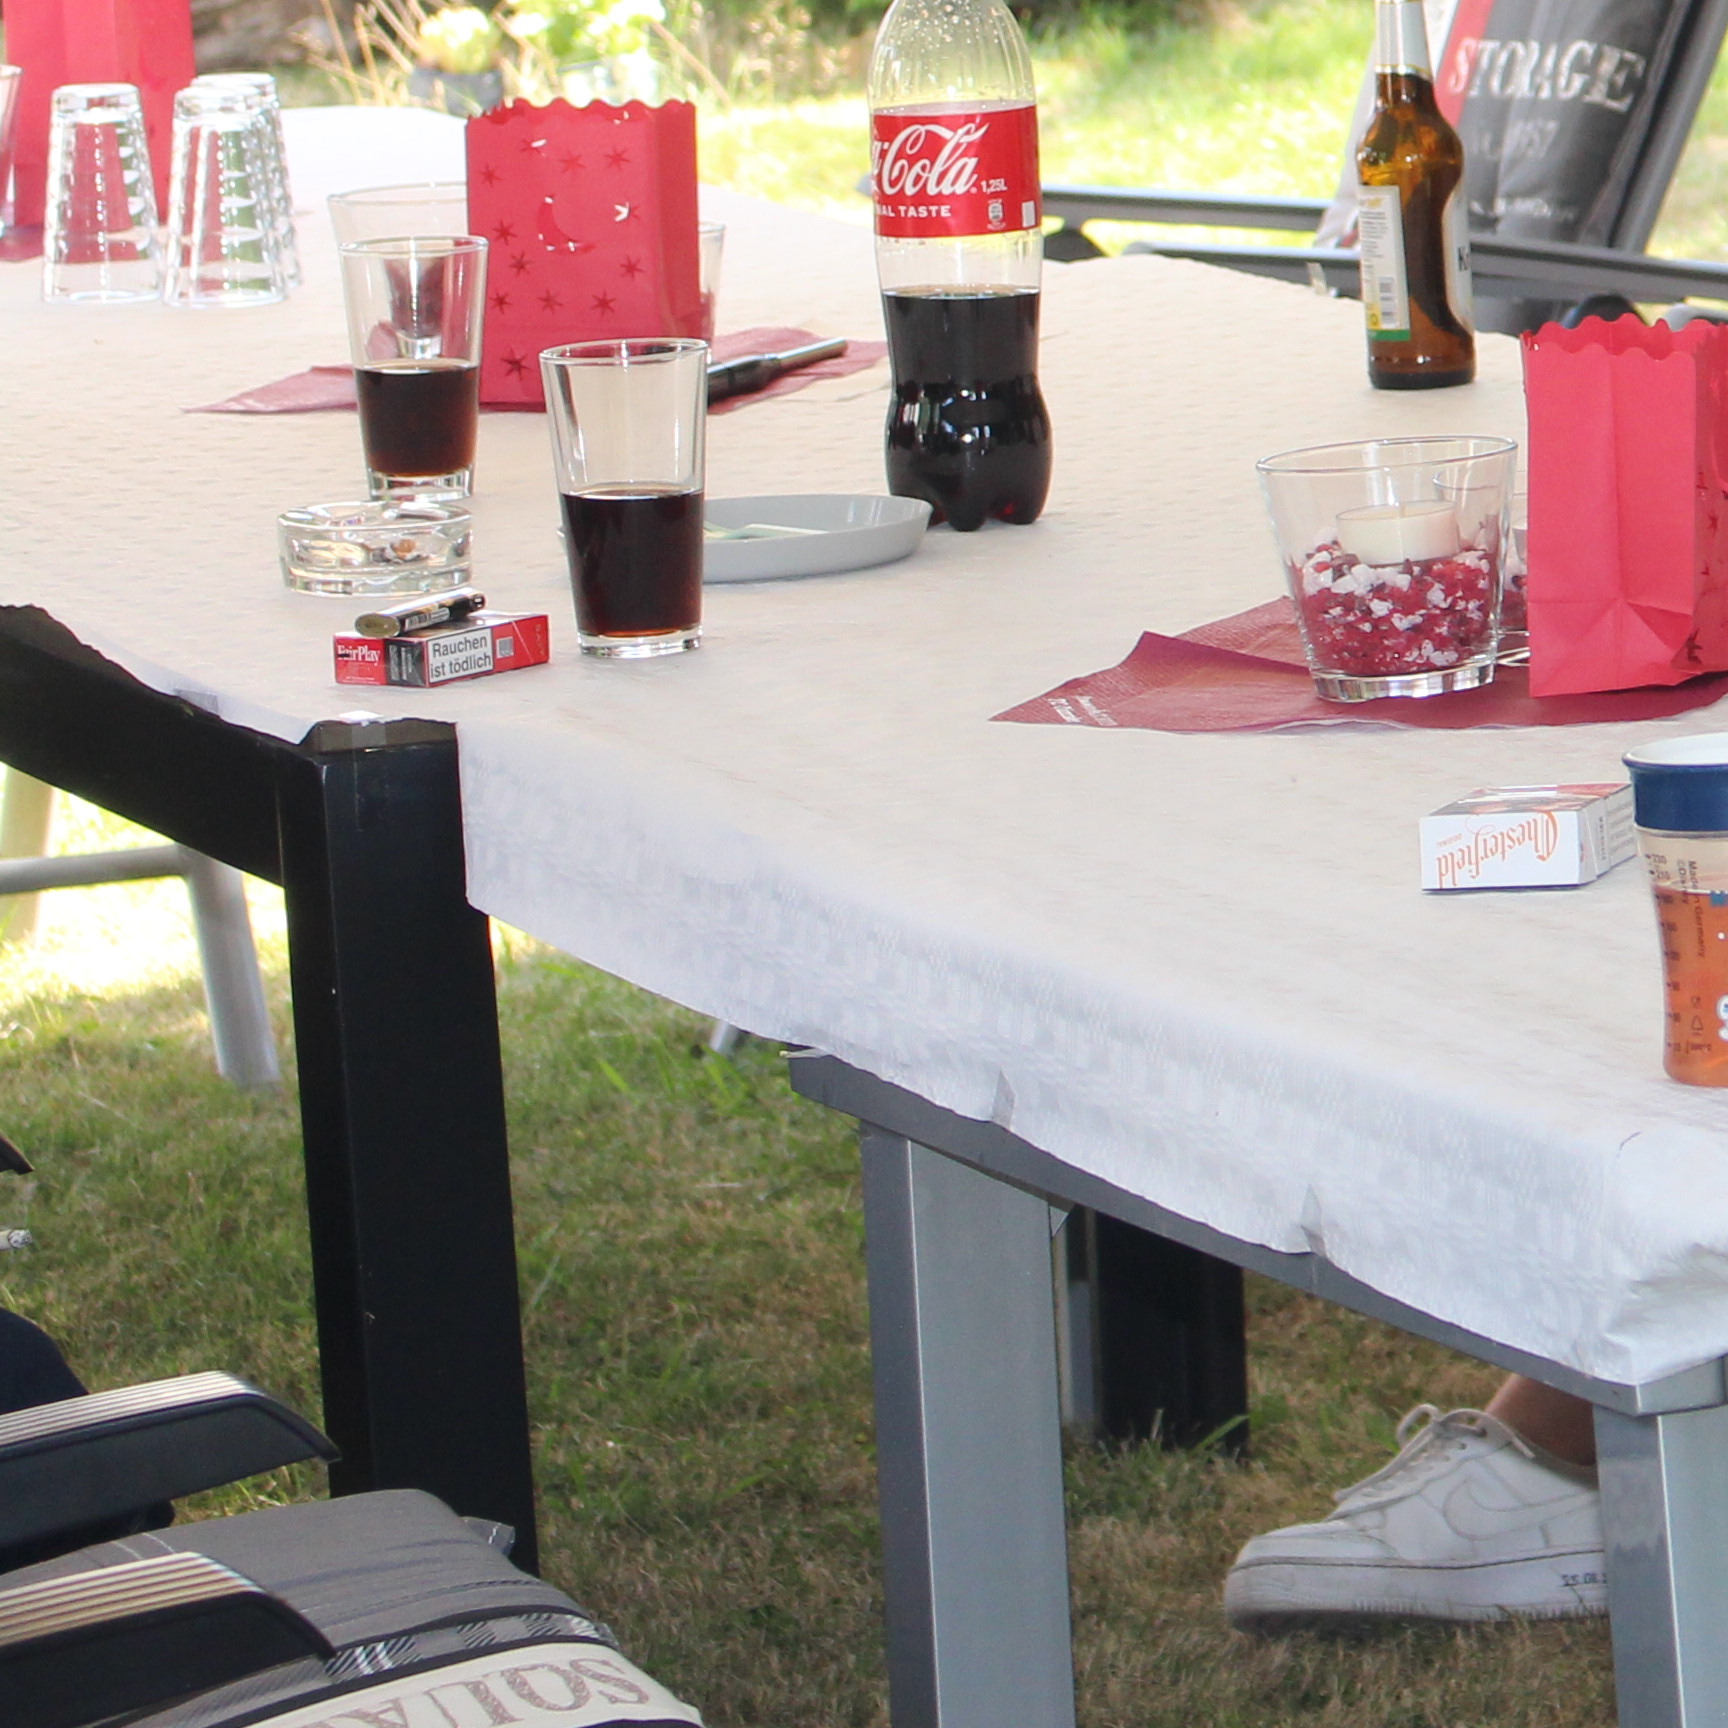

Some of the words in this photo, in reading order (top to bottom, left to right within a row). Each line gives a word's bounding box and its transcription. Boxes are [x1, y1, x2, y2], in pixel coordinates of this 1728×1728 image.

[898, 204, 952, 218] TASTE
[431, 635, 488, 659] Rauchen
[429, 663, 446, 679] ist
[448, 652, 493, 675] tödlich
[1436, 810, 1558, 889] Chesterfield
